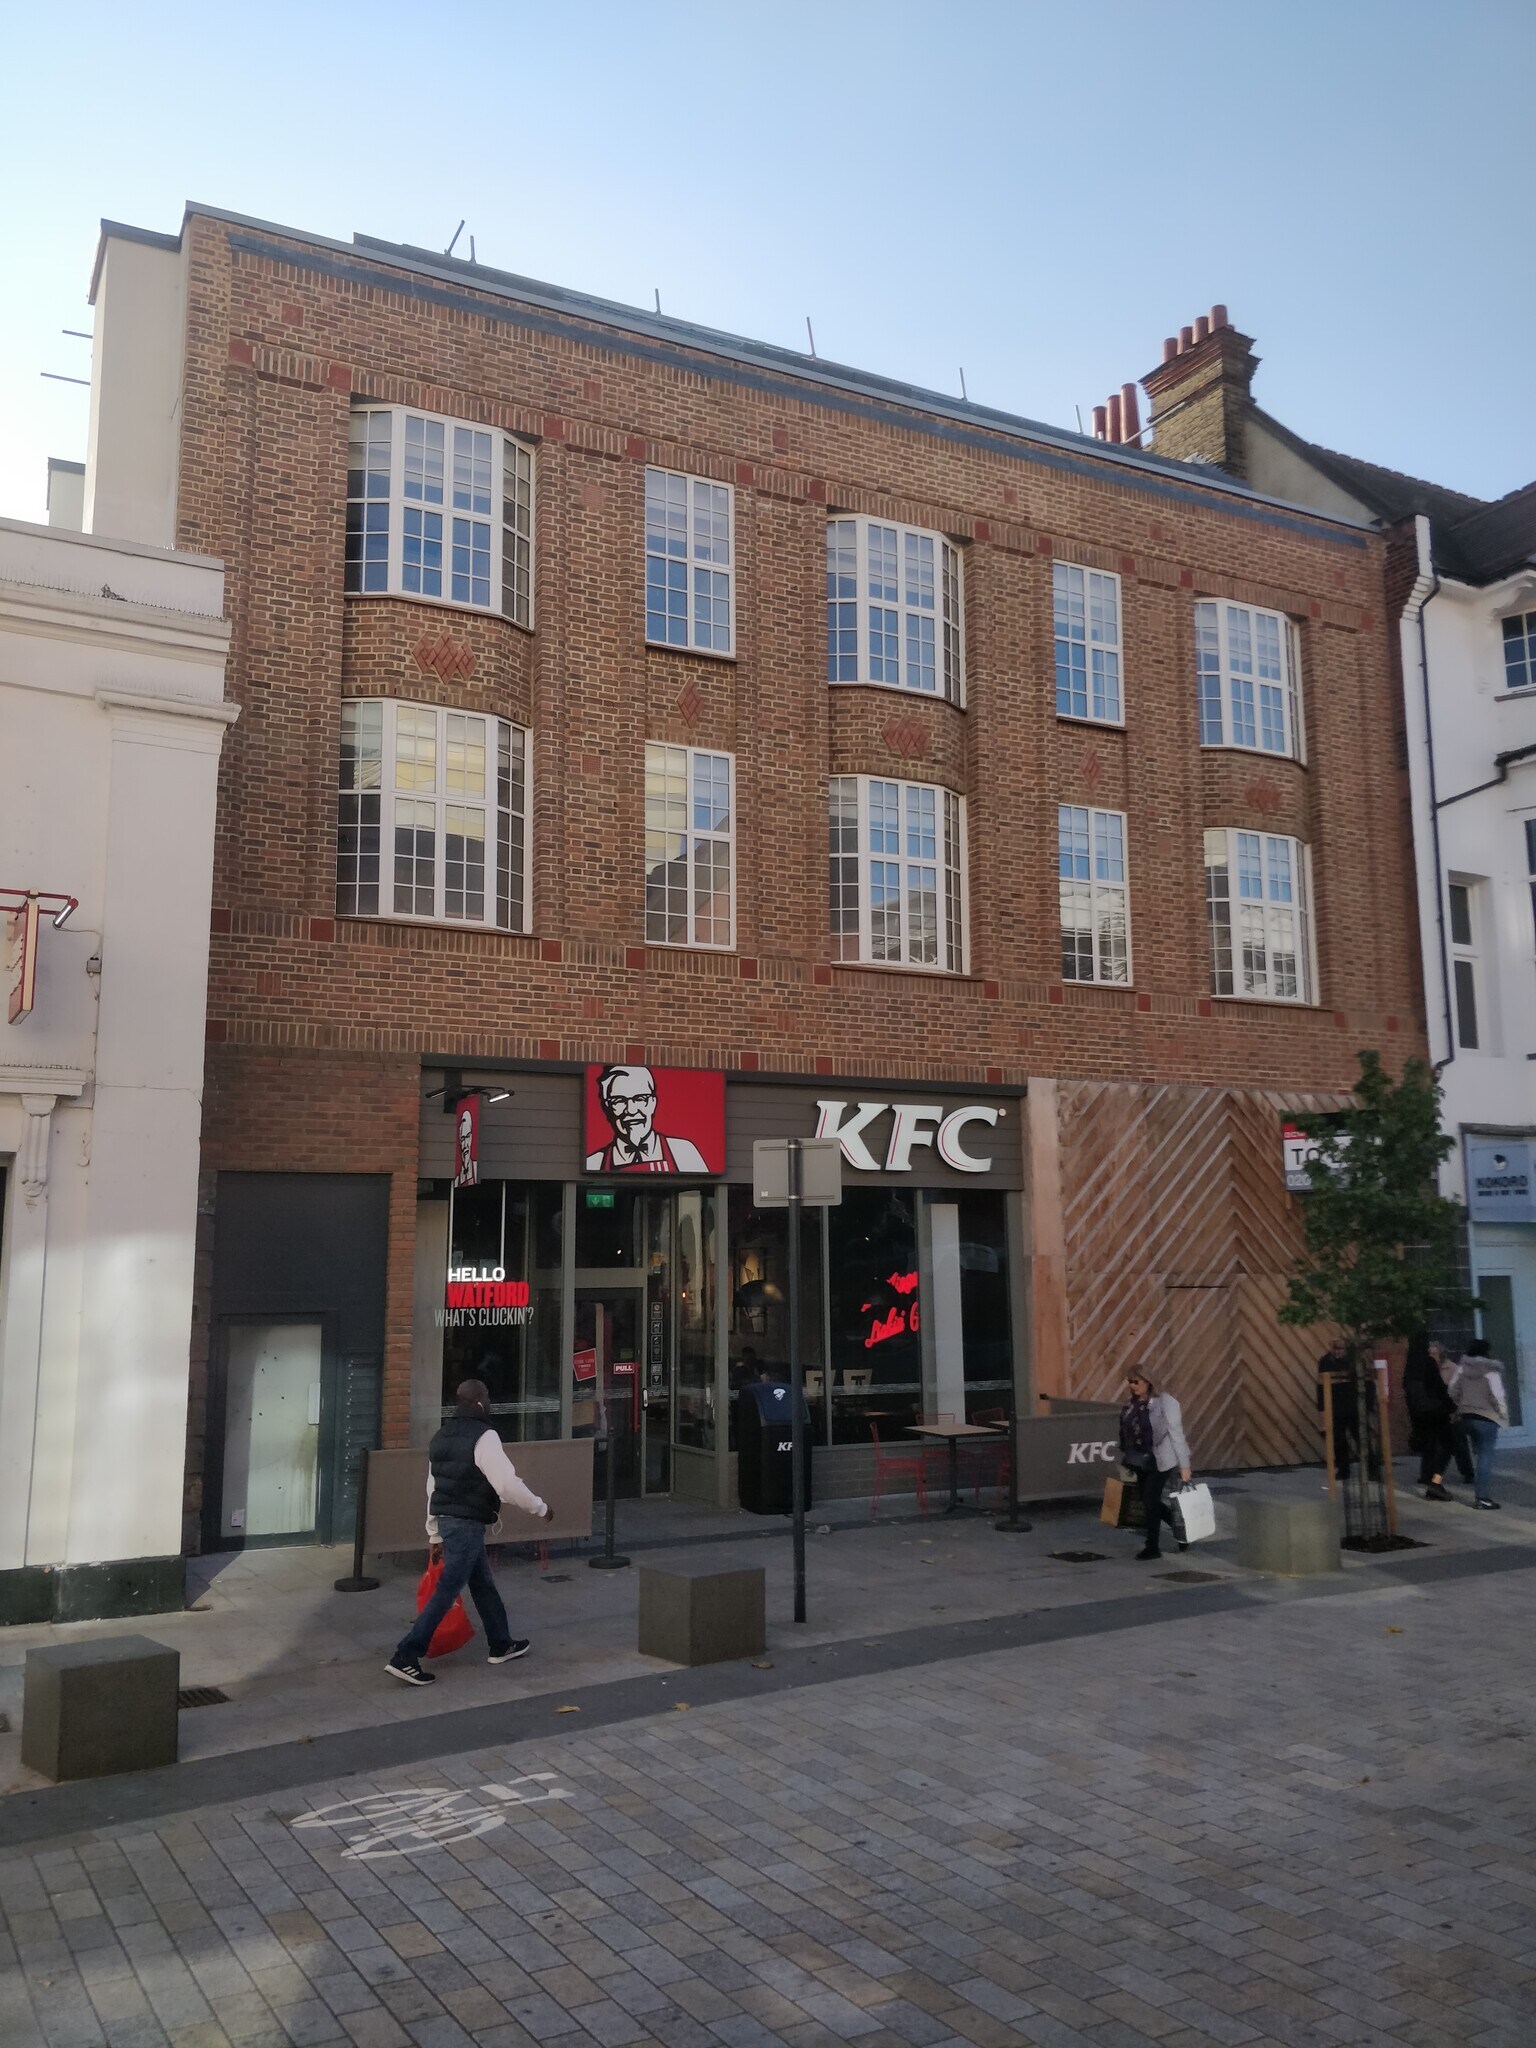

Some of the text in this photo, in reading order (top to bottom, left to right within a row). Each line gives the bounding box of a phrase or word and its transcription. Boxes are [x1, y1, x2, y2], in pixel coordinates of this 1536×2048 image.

[815, 1100, 998, 1173] KFC
[448, 1267, 506, 1282] HELLO
[447, 1281, 529, 1308] WATFORD
[434, 1307, 534, 1327] WHAT'S CLUCKIN'?
[777, 1441, 793, 1451] KF
[1066, 1441, 1118, 1464] KFC
